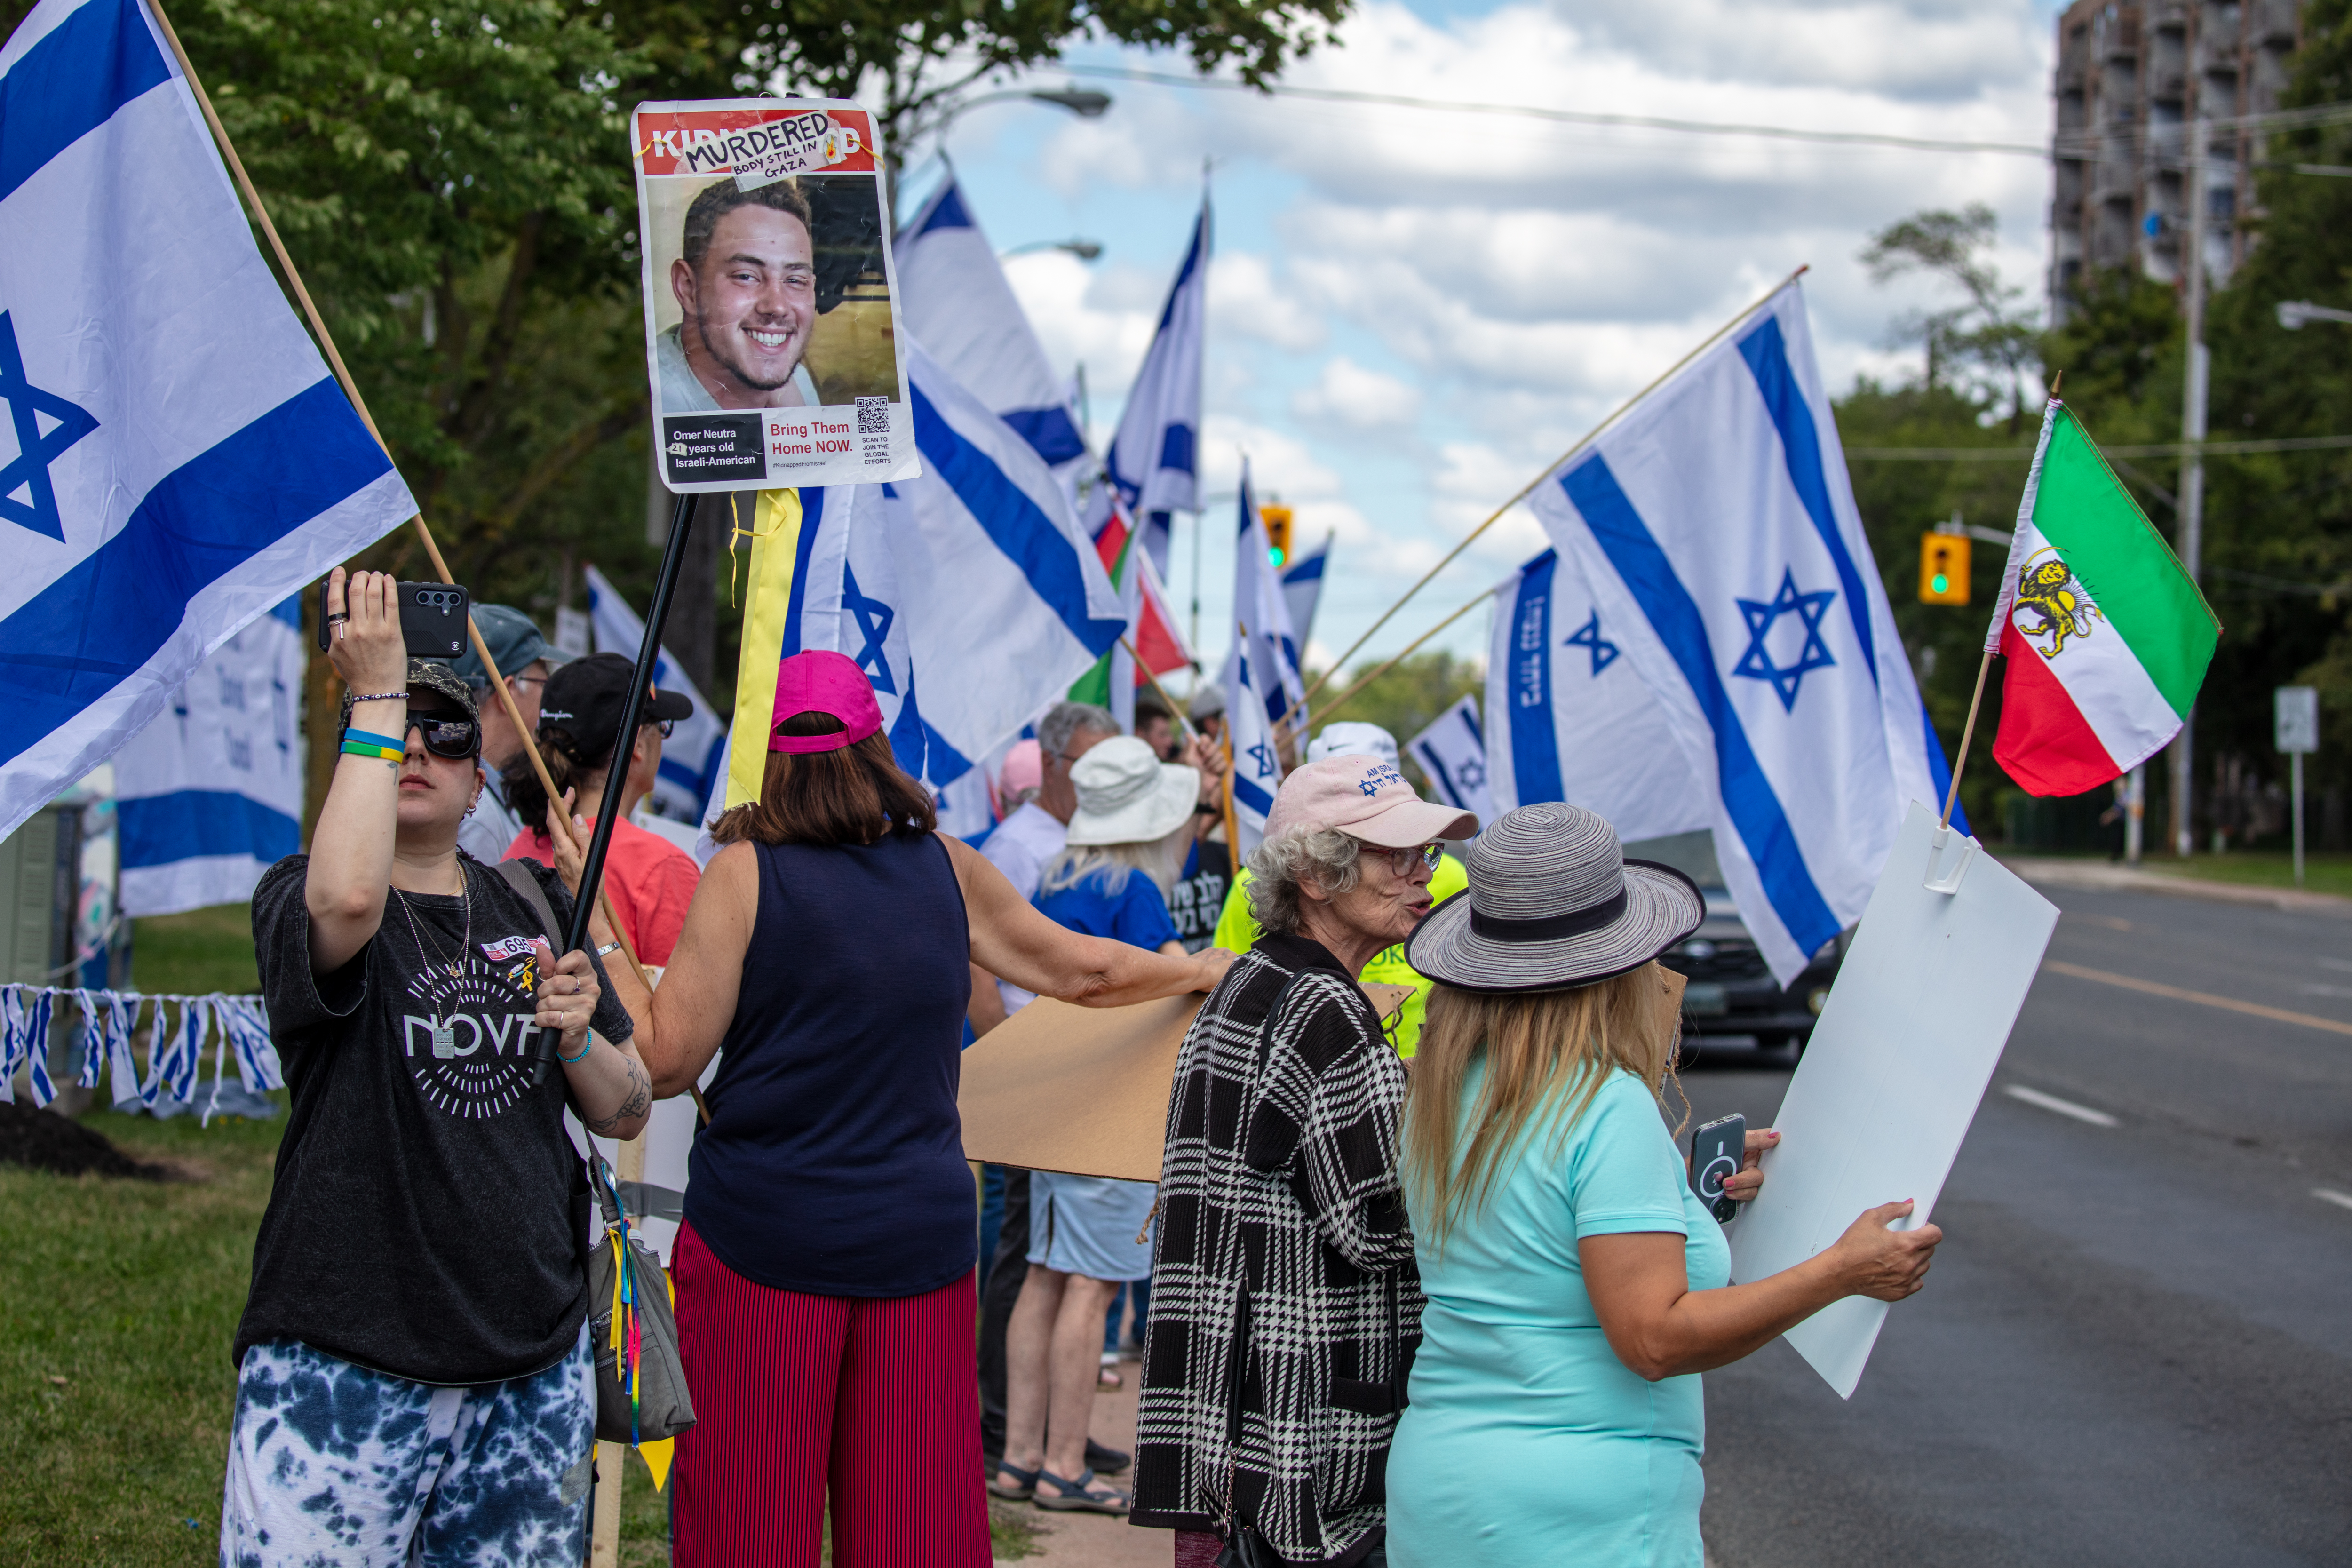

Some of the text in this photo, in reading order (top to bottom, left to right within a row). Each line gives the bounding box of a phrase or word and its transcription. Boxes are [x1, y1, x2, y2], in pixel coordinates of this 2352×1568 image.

[685, 113, 828, 172] MURDERED
[734, 140, 817, 175] BODY STILL IN
[765, 159, 807, 177] GAZA
[673, 429, 736, 440] Omer Neutra
[771, 422, 849, 438] Bring Them
[689, 442, 734, 456] years old
[772, 440, 852, 455] Home NOW.
[675, 455, 755, 468] Israeli-American
[1367, 767, 1379, 778] AM
[1372, 778, 1386, 788] חי
[504, 938, 532, 953] 695
